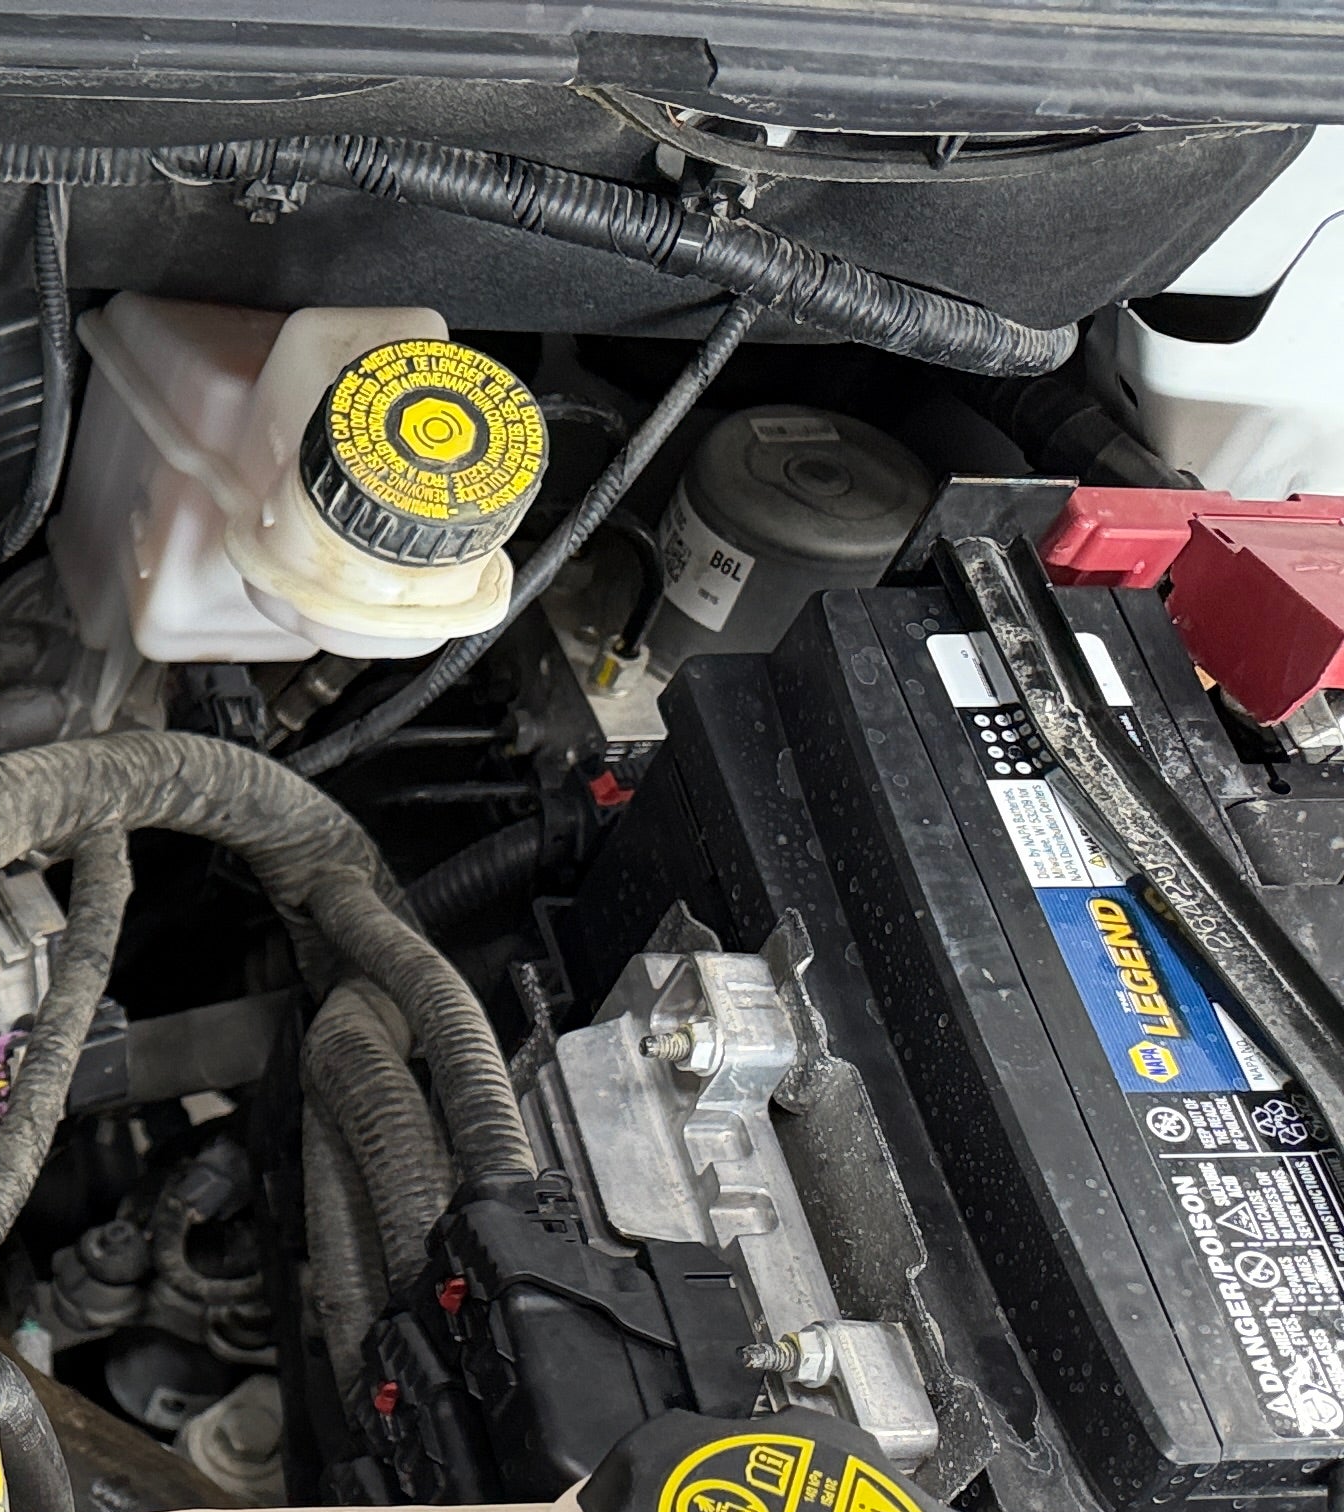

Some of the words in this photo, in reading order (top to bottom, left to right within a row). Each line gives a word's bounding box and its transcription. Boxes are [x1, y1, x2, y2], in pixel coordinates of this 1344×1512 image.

[375, 358, 408, 384] AVANT
[412, 356, 429, 371] DE
[331, 371, 362, 412] BEFORE
[509, 387, 530, 405] LE
[330, 413, 350, 439] CAP
[349, 408, 366, 427] DOT
[407, 371, 472, 394] PROVENANT
[483, 409, 506, 467] CONTENANT
[519, 405, 542, 454] BOUCHON
[352, 428, 372, 452] ONLY
[501, 423, 524, 474] SEULEMENT
[337, 440, 370, 478] FILLER
[362, 451, 388, 475] USE
[375, 440, 409, 473] SEALED
[521, 454, 541, 472] DE
[416, 470, 447, 488] FROM
[489, 468, 511, 489] DU
[710, 549, 743, 583] B6L
[1032, 784, 1052, 813] Centers
[1016, 825, 1035, 846] NAPA
[1032, 826, 1046, 836] WI
[1064, 860, 1082, 881] NAPA
[1085, 897, 1182, 1038] LEGEND
[1138, 1048, 1168, 1075] NAPA
[1245, 1054, 1265, 1081] NAPA
[1183, 1097, 1200, 1110] OF
[1200, 1101, 1223, 1128] REACH
[1188, 1109, 1207, 1128] OUT
[1196, 1128, 1217, 1149] KEEP
[1212, 1128, 1231, 1146] THE
[1233, 1138, 1250, 1150] OF
[1198, 1162, 1231, 1207] SULFURIC
[1221, 1175, 1245, 1198] ACID
[1256, 1171, 1273, 1186] OR
[1246, 1189, 1272, 1221] CAUSE
[1263, 1187, 1298, 1239] BLINDNESS
[1260, 1222, 1280, 1240] CAN
[1286, 1202, 1315, 1239] SEVERE
[1171, 1175, 1287, 1393] DANGER/POISON
[1278, 1256, 1306, 1294] SPARKS
[1294, 1255, 1322, 1294] FLAMES
[1307, 1248, 1338, 1294] SMOKING
[1271, 1286, 1294, 1303] NO
[1265, 1318, 1296, 1357] SHIELD
[826, 1477, 839, 1491] 20
[820, 1490, 835, 1508] PSI
